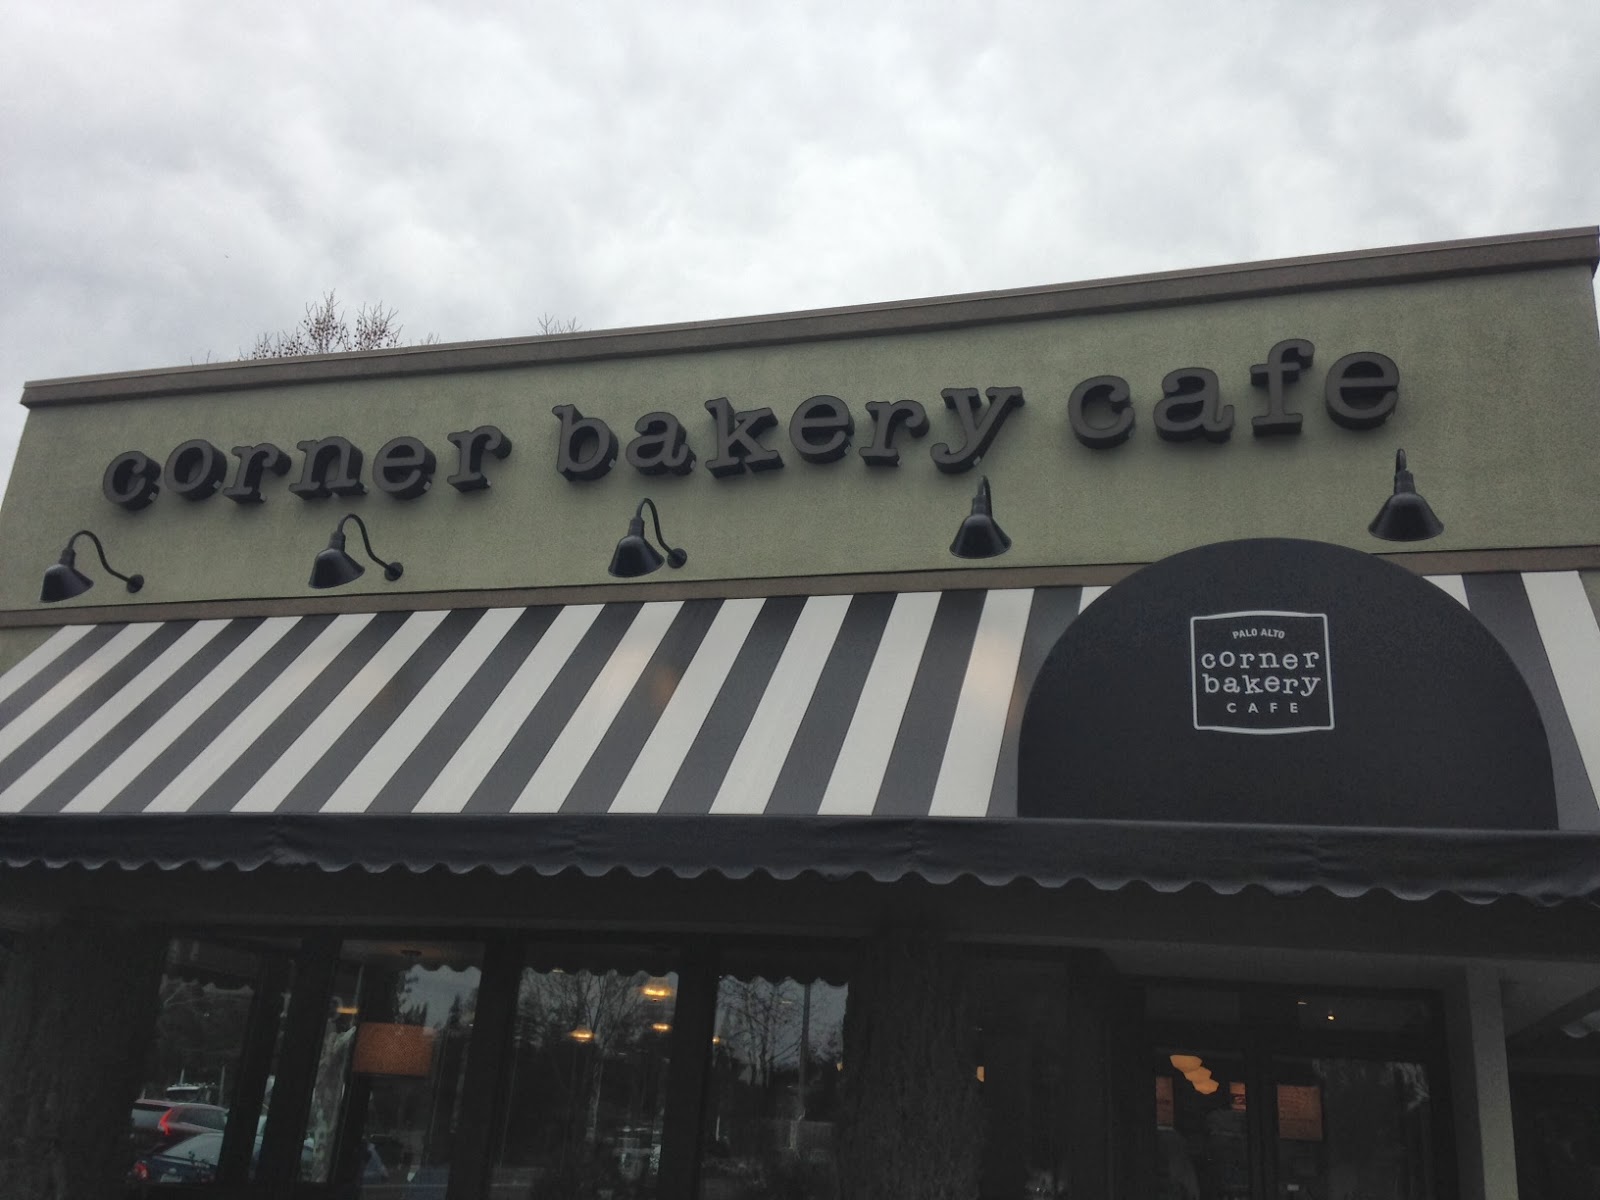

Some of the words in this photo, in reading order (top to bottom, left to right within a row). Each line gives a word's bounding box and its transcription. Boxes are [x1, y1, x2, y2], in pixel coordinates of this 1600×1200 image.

[103, 425, 512, 511] corner
[552, 387, 1023, 481] bakery
[1067, 338, 1400, 450] cafe
[1232, 628, 1258, 640] PALO
[1260, 628, 1286, 640] ALTO
[1201, 651, 1320, 670] corner
[1202, 673, 1321, 697] bakery
[1226, 702, 1299, 714] CAFE
